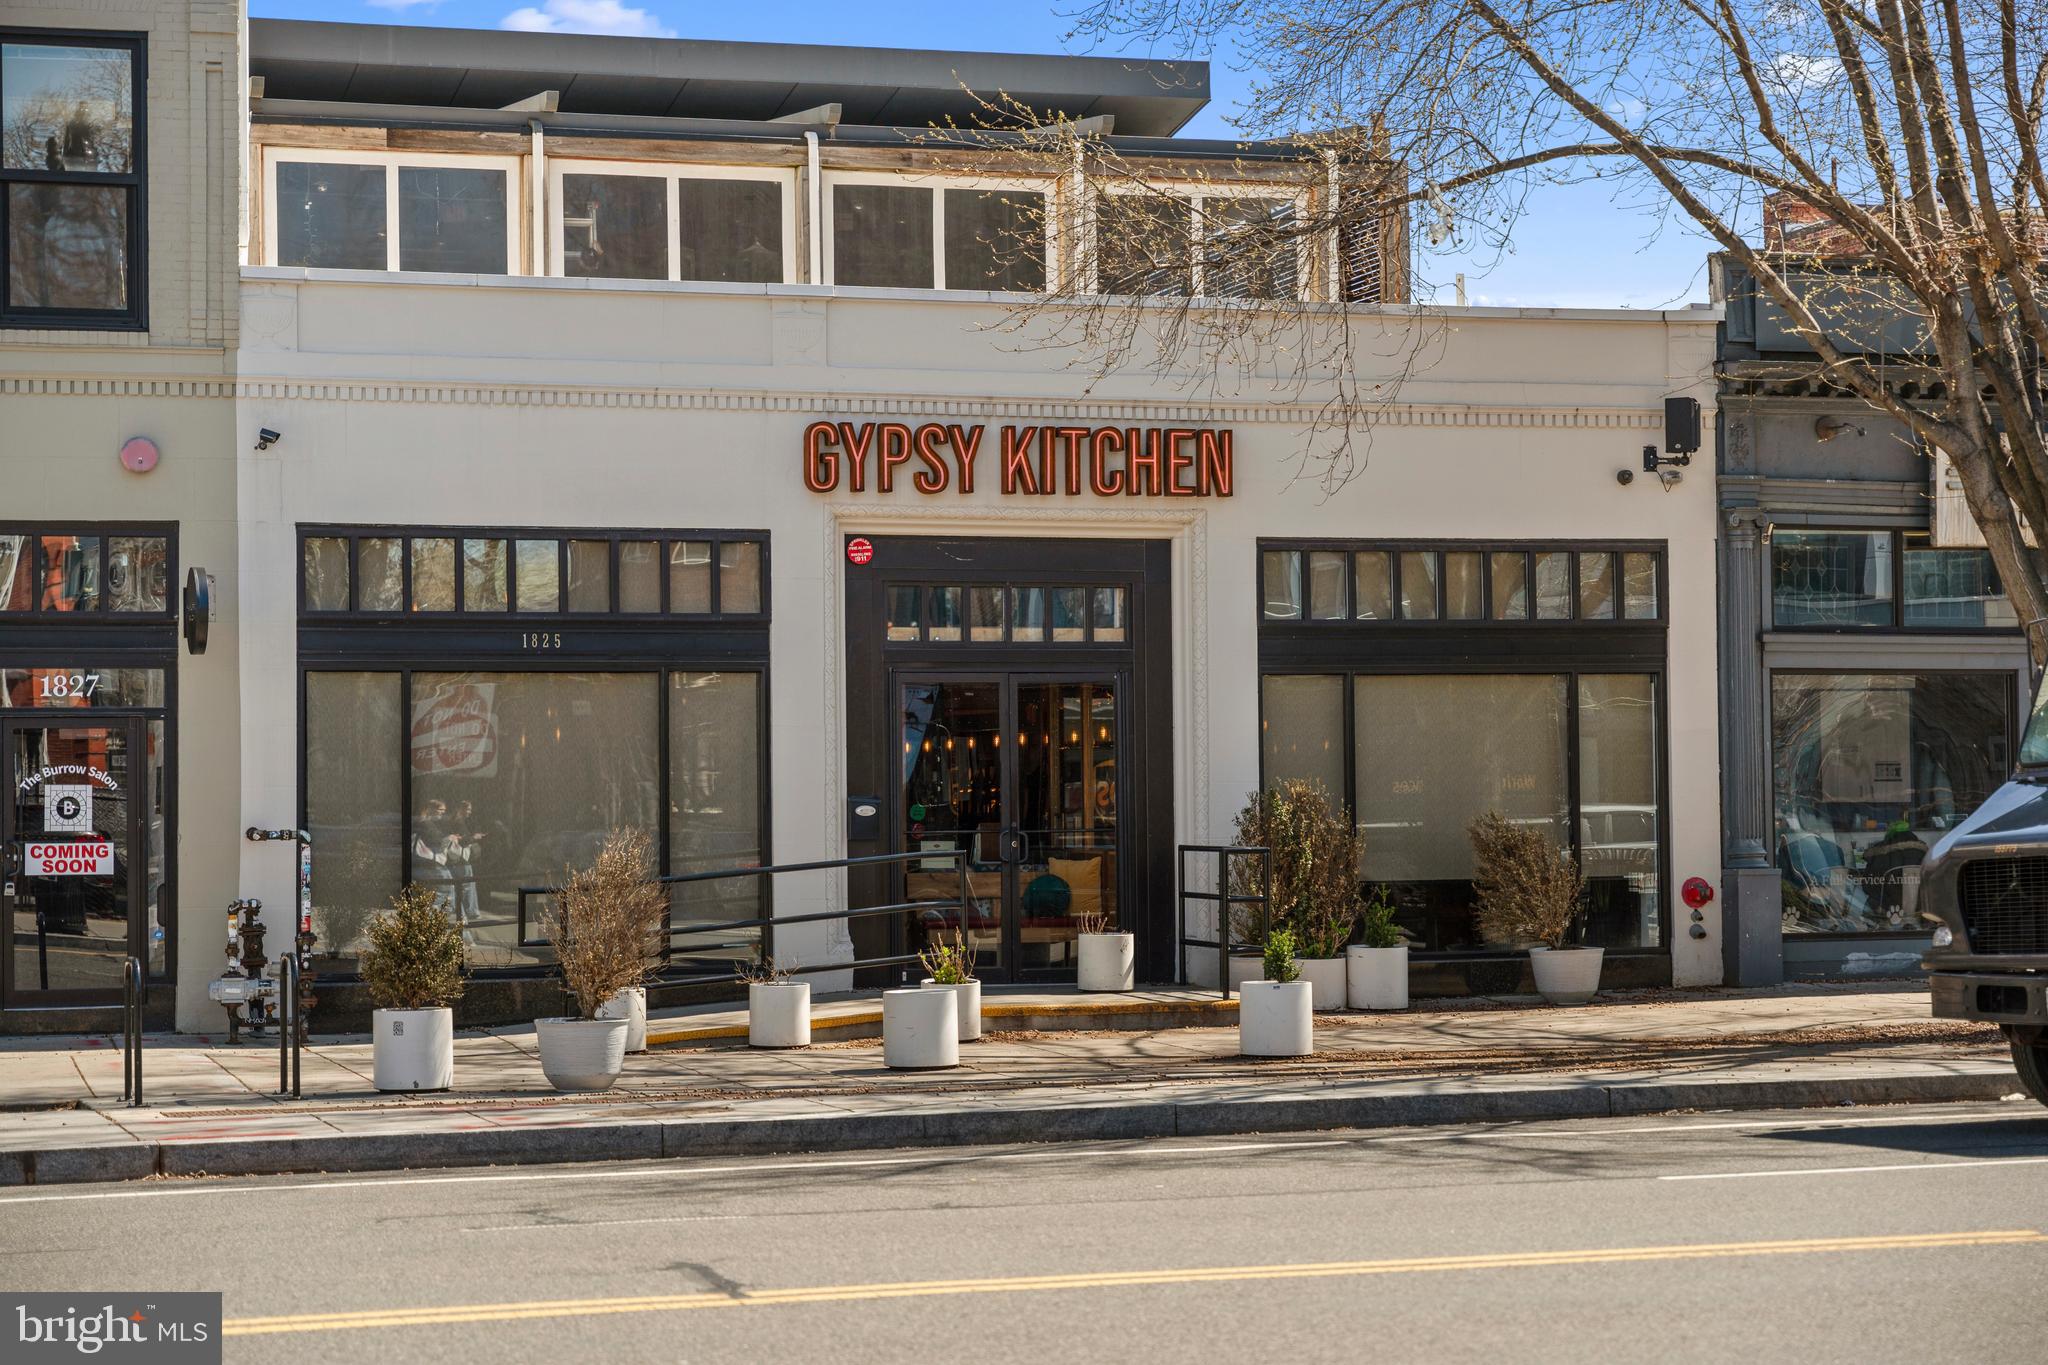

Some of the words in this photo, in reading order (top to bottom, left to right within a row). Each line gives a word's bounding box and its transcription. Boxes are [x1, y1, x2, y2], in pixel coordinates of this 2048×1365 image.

[803, 421, 985, 494] GYPSY
[1000, 425, 1234, 498] KITCHEN
[522, 633, 561, 648] 1825
[40, 674, 100, 698] 1827
[20, 773, 42, 791] The
[42, 764, 87, 778] Burrow
[88, 766, 118, 791] Salon
[63, 800, 74, 815] B
[30, 844, 109, 859] COMING
[42, 859, 97, 873] SOON
[1847, 873, 1885, 885] Service
